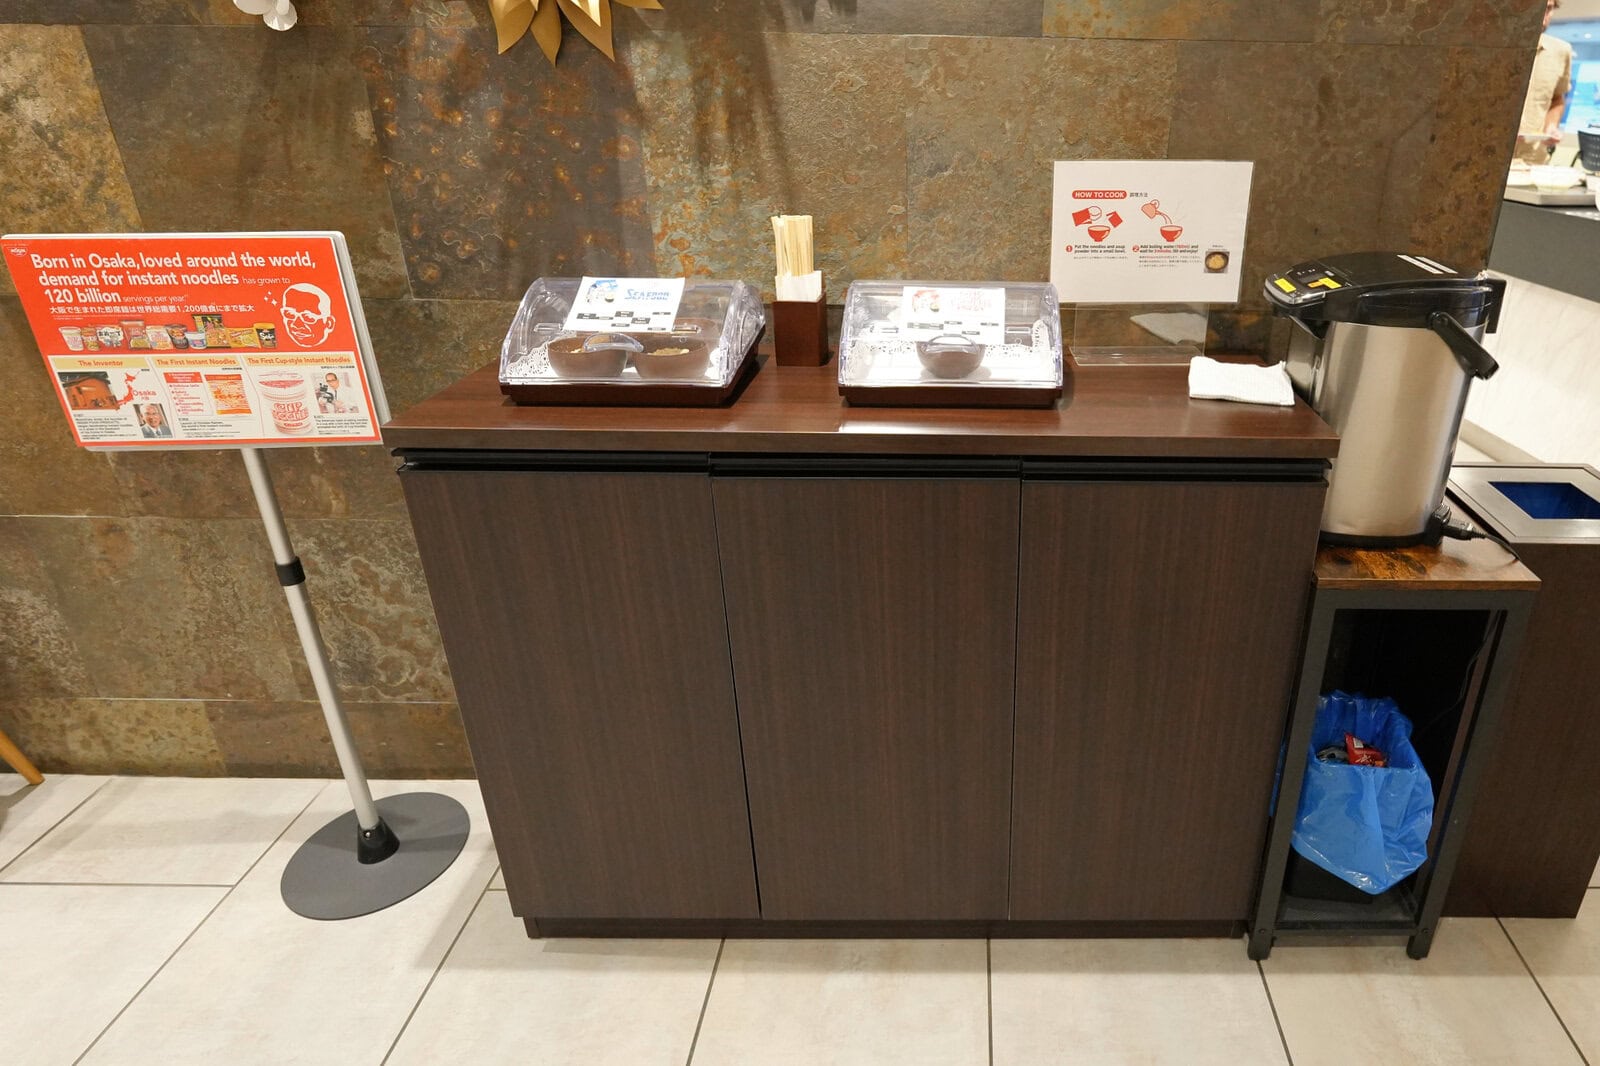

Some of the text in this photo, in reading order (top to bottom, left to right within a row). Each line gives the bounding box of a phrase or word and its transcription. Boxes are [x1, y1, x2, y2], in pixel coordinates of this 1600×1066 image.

[30, 251, 316, 271] Born in Osaka, loved around the world,
[39, 270, 99, 286] demand
[101, 270, 123, 286] for
[126, 270, 179, 286] instant
[180, 269, 240, 285] noodles
[242, 276, 256, 284] has
[257, 277, 281, 287] grown
[44, 288, 74, 304] 120
[74, 287, 121, 304] billion
[122, 293, 153, 305] servings
[154, 295, 167, 304] per
[156, 358, 169, 366] The
[169, 358, 185, 366] First
[208, 357, 236, 365] Noodles
[247, 357, 260, 365] The
[303, 356, 325, 364] Instant
[325, 355, 351, 363] Noodles
